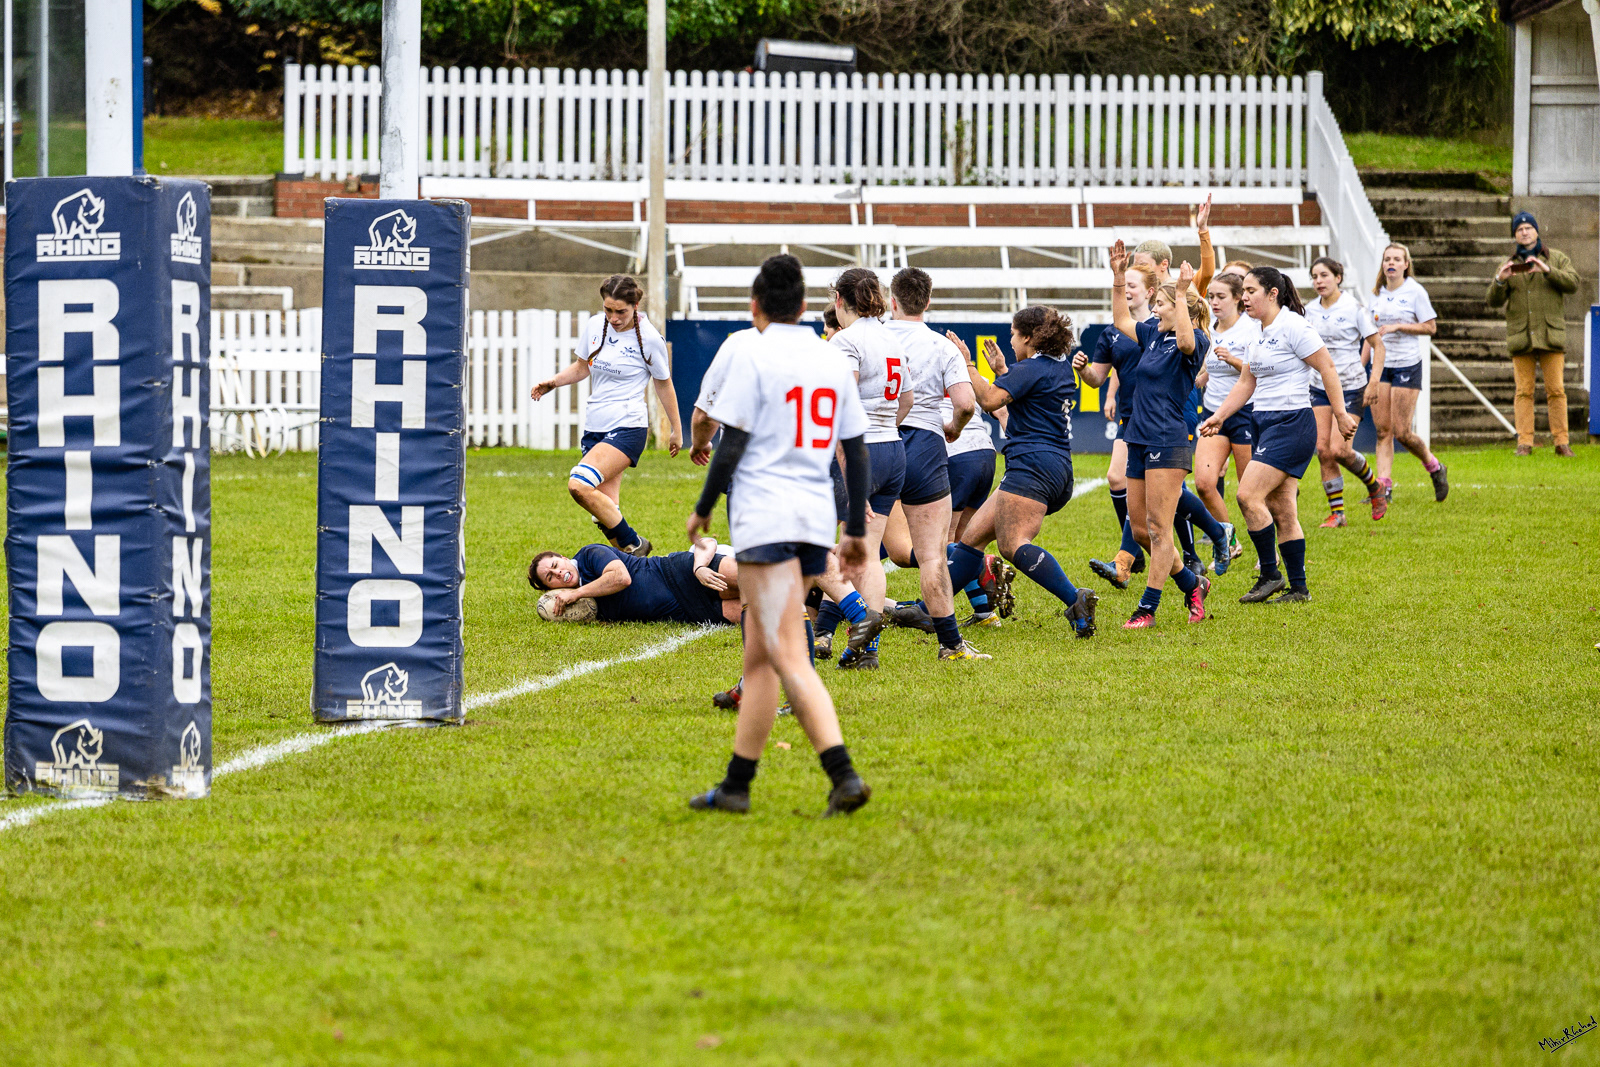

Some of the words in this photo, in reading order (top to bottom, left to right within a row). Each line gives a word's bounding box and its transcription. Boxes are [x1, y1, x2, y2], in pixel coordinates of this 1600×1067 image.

[36, 238, 120, 257] RHINO
[171, 239, 202, 259] RHINO
[353, 250, 430, 266] RHINO
[603, 366, 621, 374] County
[884, 357, 902, 401] 5
[786, 386, 837, 449] 19
[347, 284, 428, 648] RHINO
[37, 278, 121, 703] RHINO
